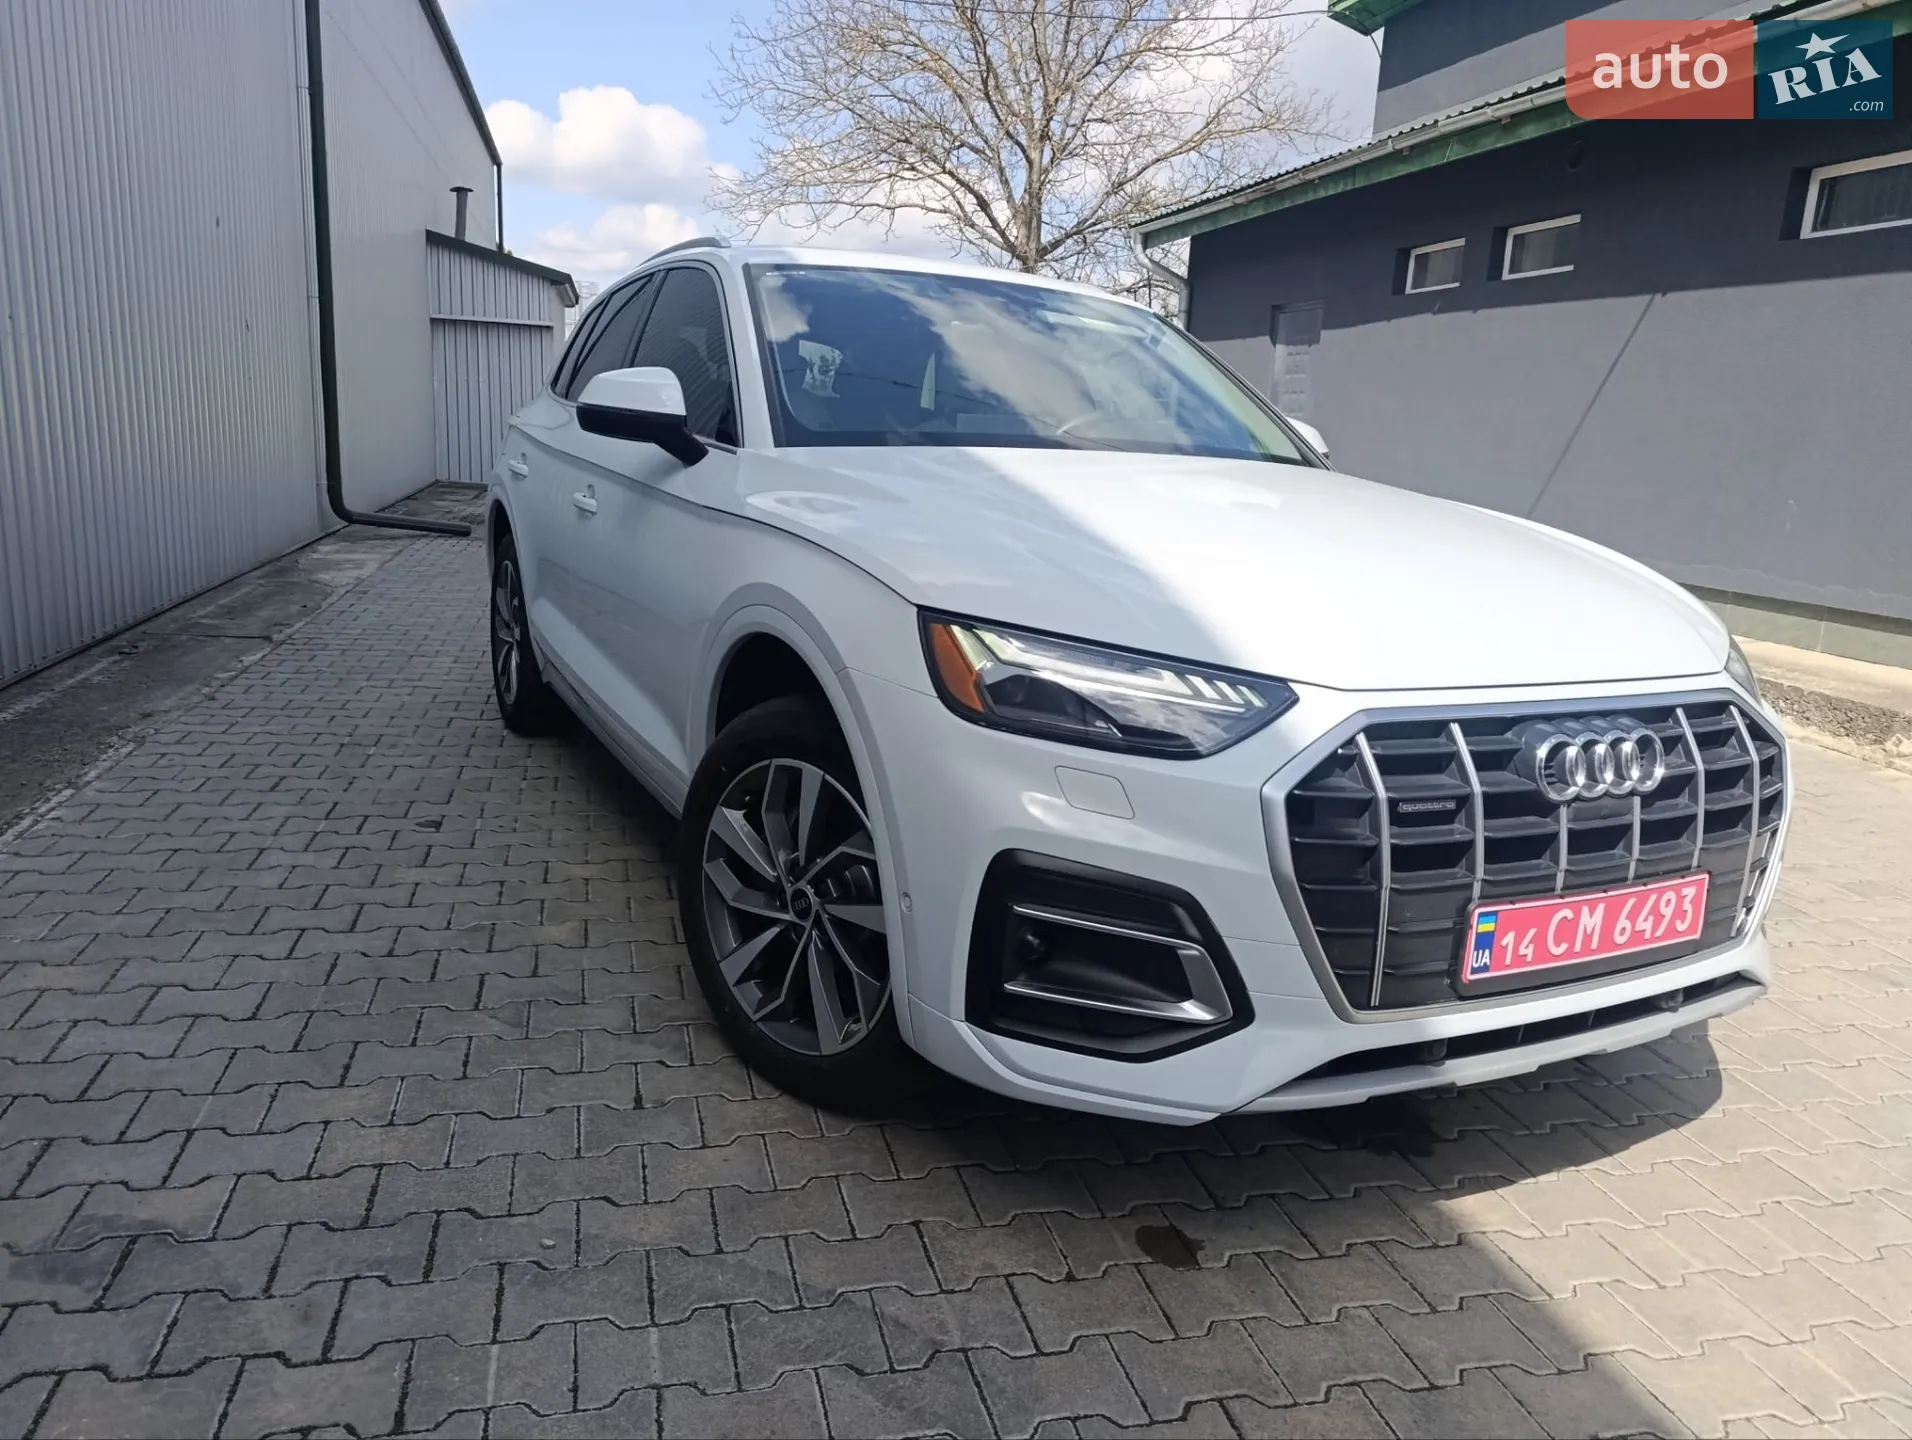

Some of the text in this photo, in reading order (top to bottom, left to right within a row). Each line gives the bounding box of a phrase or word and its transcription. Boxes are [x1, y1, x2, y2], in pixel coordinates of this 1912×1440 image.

[1402, 802, 1454, 811] quattro
[1500, 886, 1697, 966] 14 CM 6493
[1472, 949, 1491, 967] UA
